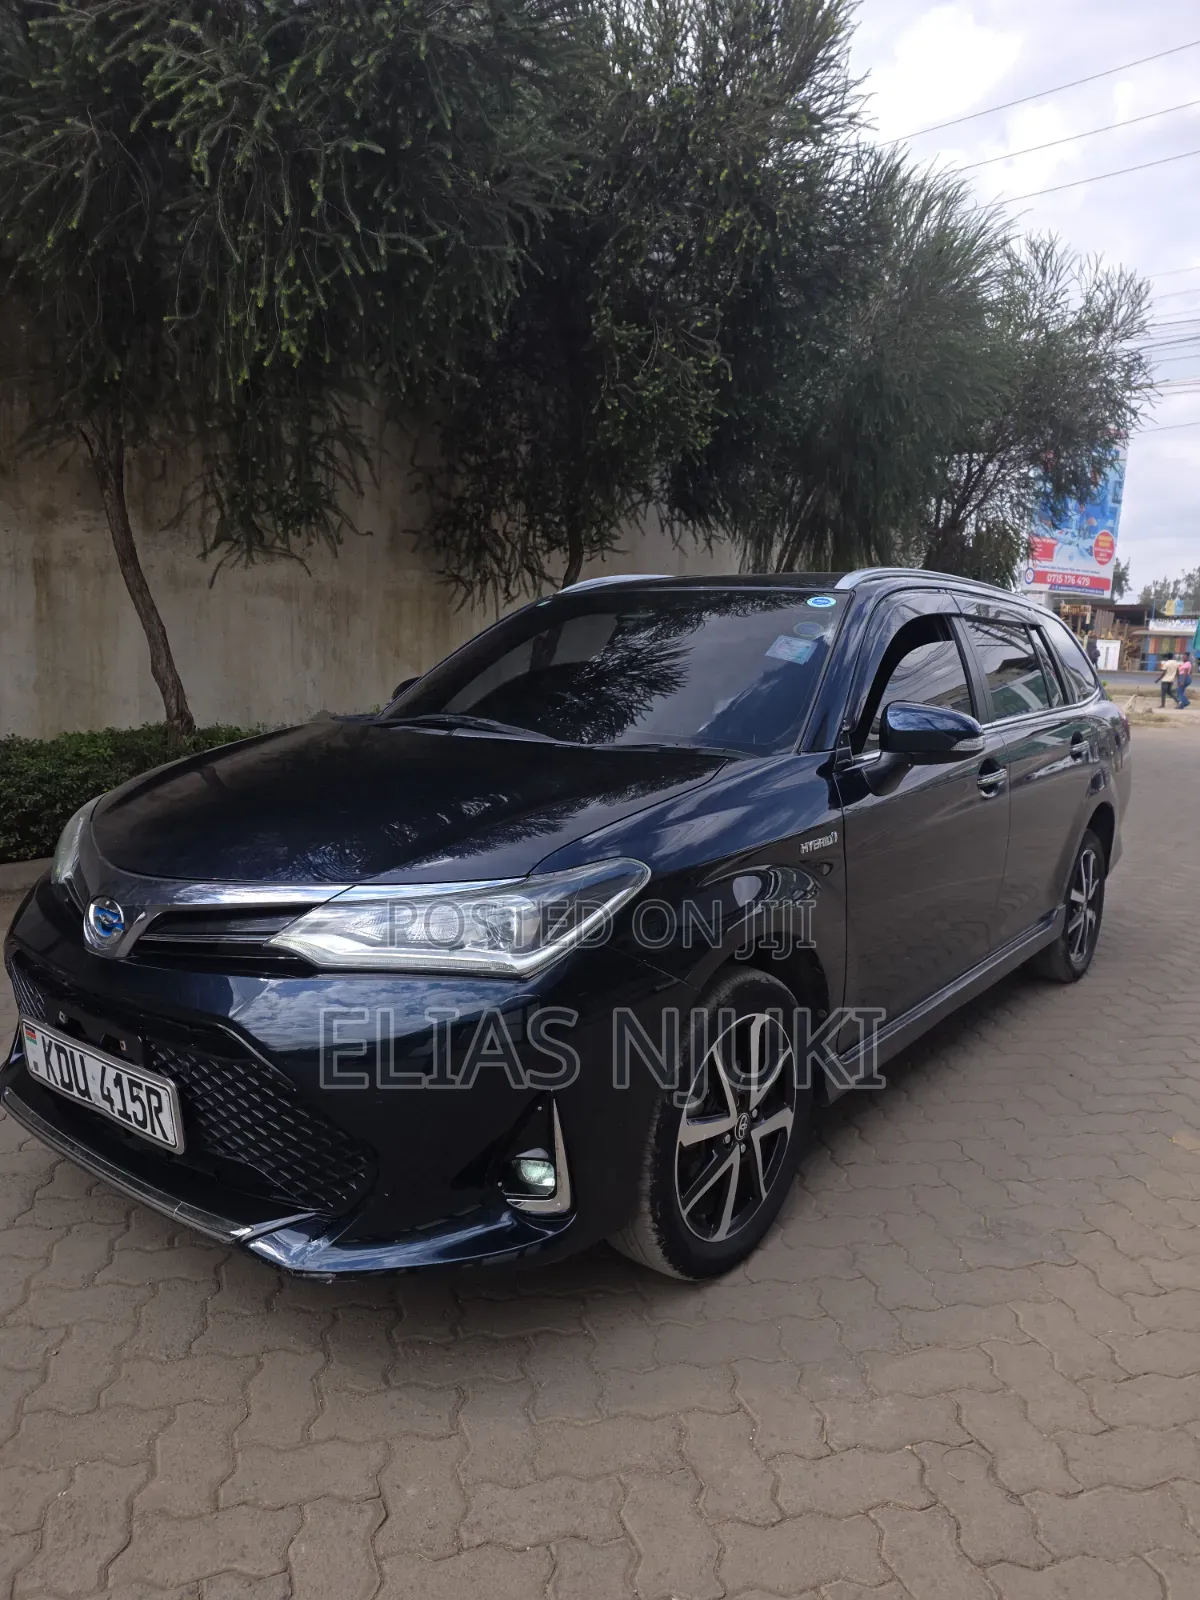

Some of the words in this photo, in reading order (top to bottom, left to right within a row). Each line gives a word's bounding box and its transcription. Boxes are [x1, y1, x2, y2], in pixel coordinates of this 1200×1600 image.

[1047, 573, 1062, 583] 0715
[1064, 575, 1075, 584] 176
[1077, 576, 1090, 586] 479
[800, 834, 833, 854] HYBRID
[42, 1036, 92, 1101] KDU
[101, 1066, 169, 1141] 415R
